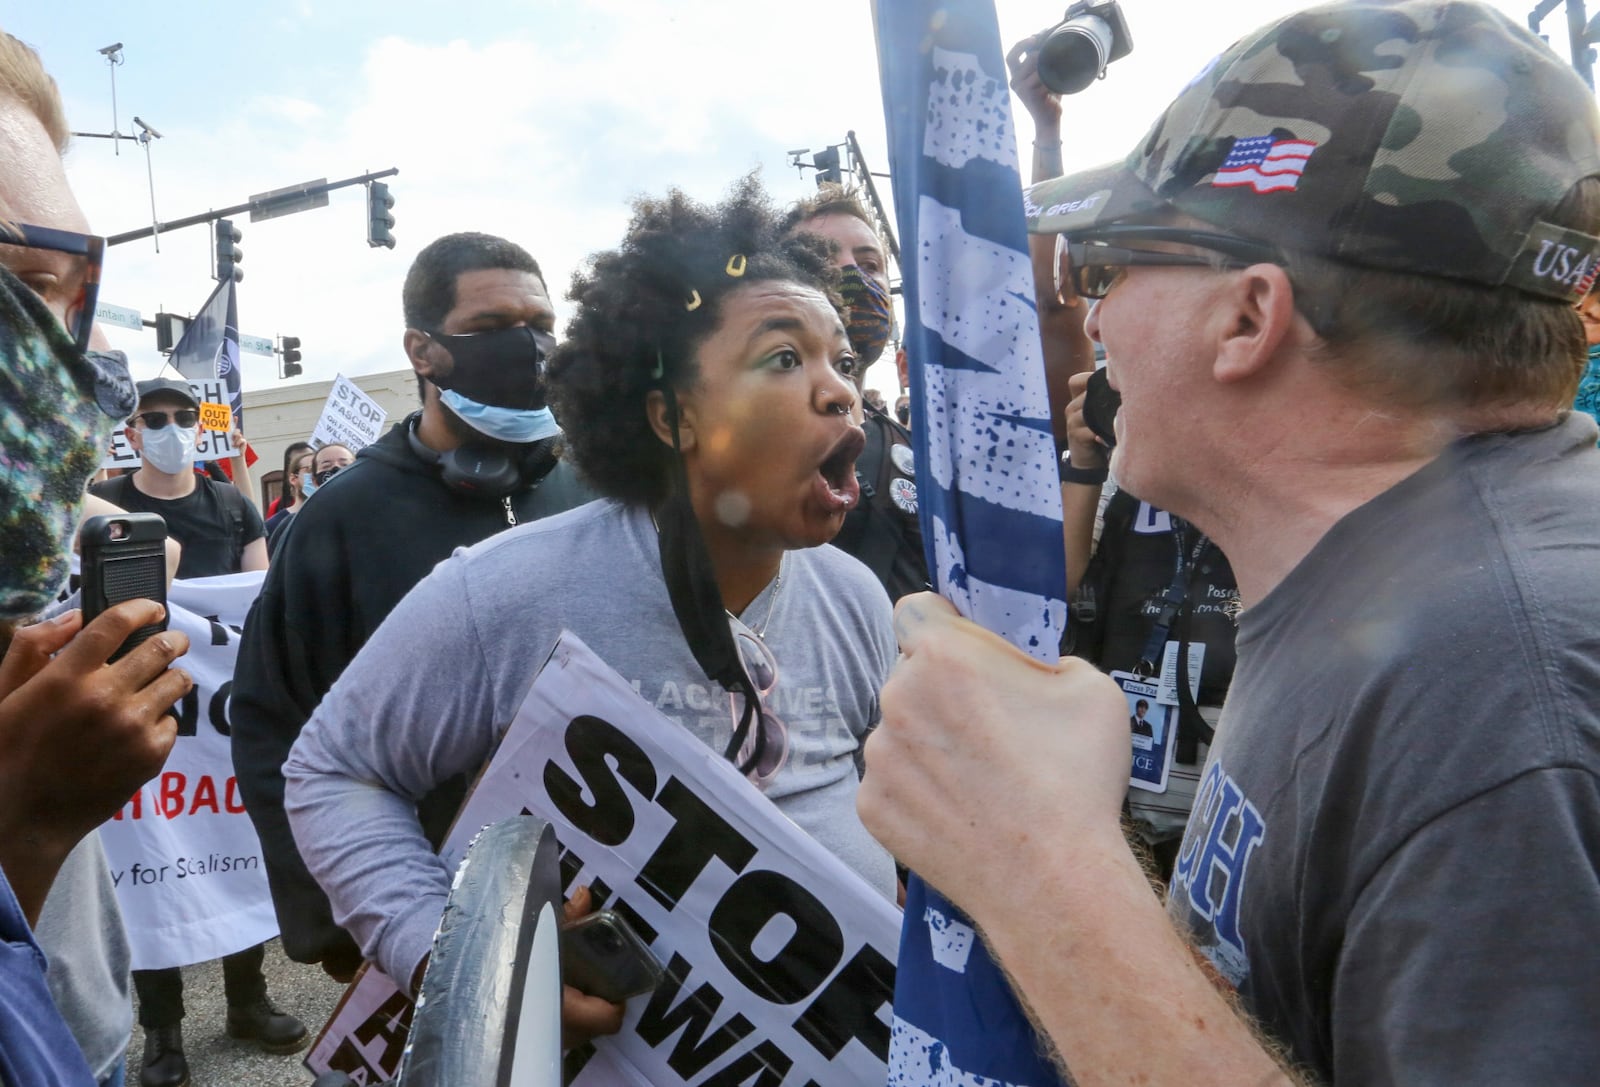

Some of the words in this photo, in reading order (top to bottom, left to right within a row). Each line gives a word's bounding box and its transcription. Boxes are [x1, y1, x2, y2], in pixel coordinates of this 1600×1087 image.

[1046, 196, 1101, 217] GREAT
[1533, 239, 1592, 287] USA
[95, 308, 126, 323] untain
[337, 384, 381, 423] STOP
[202, 418, 229, 429] NOW
[204, 409, 228, 420] OUT
[331, 400, 375, 439] FASCISM
[1125, 681, 1144, 693] Press
[131, 863, 168, 886] for
